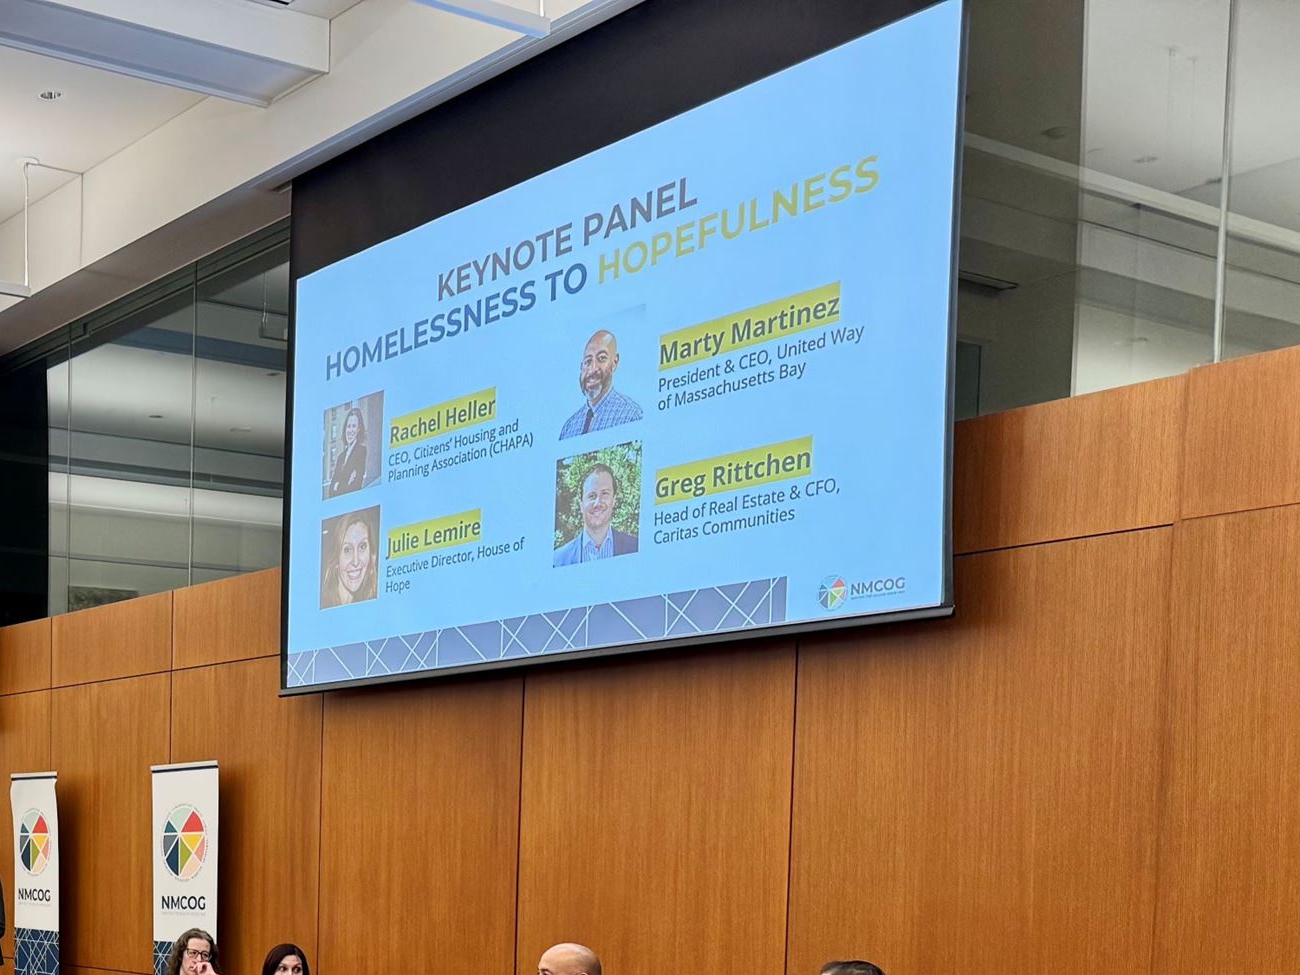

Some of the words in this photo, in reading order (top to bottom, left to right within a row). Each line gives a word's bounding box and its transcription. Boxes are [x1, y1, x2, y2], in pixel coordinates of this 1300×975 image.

[437, 222, 572, 302] KEYNOTE
[584, 177, 698, 247] PANEL
[326, 280, 537, 381] HOMELESSNESS
[545, 263, 588, 302] TO
[598, 154, 881, 284] HOPEFULNESS
[659, 331, 725, 365] Marty
[731, 297, 840, 345] Martinez
[658, 363, 721, 392] President
[724, 359, 735, 374] &
[738, 350, 772, 370] CEO,
[777, 332, 826, 360] United
[831, 326, 865, 345] Way
[658, 394, 672, 411] of
[674, 369, 775, 407] Massachusetts
[779, 362, 807, 380] Bay
[388, 451, 411, 467] CEO,
[454, 426, 496, 447] Housing
[498, 418, 519, 435] and
[390, 411, 441, 444] Rachel
[445, 399, 496, 428] Heller
[388, 458, 430, 483] Planning
[431, 445, 487, 472] Association
[489, 432, 534, 458] (CHAPA)
[655, 472, 706, 498] Greg
[713, 450, 811, 487] Rittchen
[654, 506, 688, 526] Head
[693, 502, 707, 519] of
[709, 496, 737, 516] Real
[742, 488, 785, 510] Estate
[789, 485, 801, 500] &
[805, 478, 840, 497] CFO,
[385, 532, 419, 560] Julie
[424, 520, 481, 546] Lemire
[653, 526, 699, 545] Caritas
[702, 508, 795, 536] Communities
[386, 558, 429, 578] Executive
[431, 549, 475, 569] Director,
[477, 542, 511, 560] House
[513, 536, 525, 551] of
[385, 578, 411, 594] Hope
[850, 576, 906, 597] NMCOG
[18, 887, 51, 902] NMCOG
[161, 895, 206, 910] NMCOG
